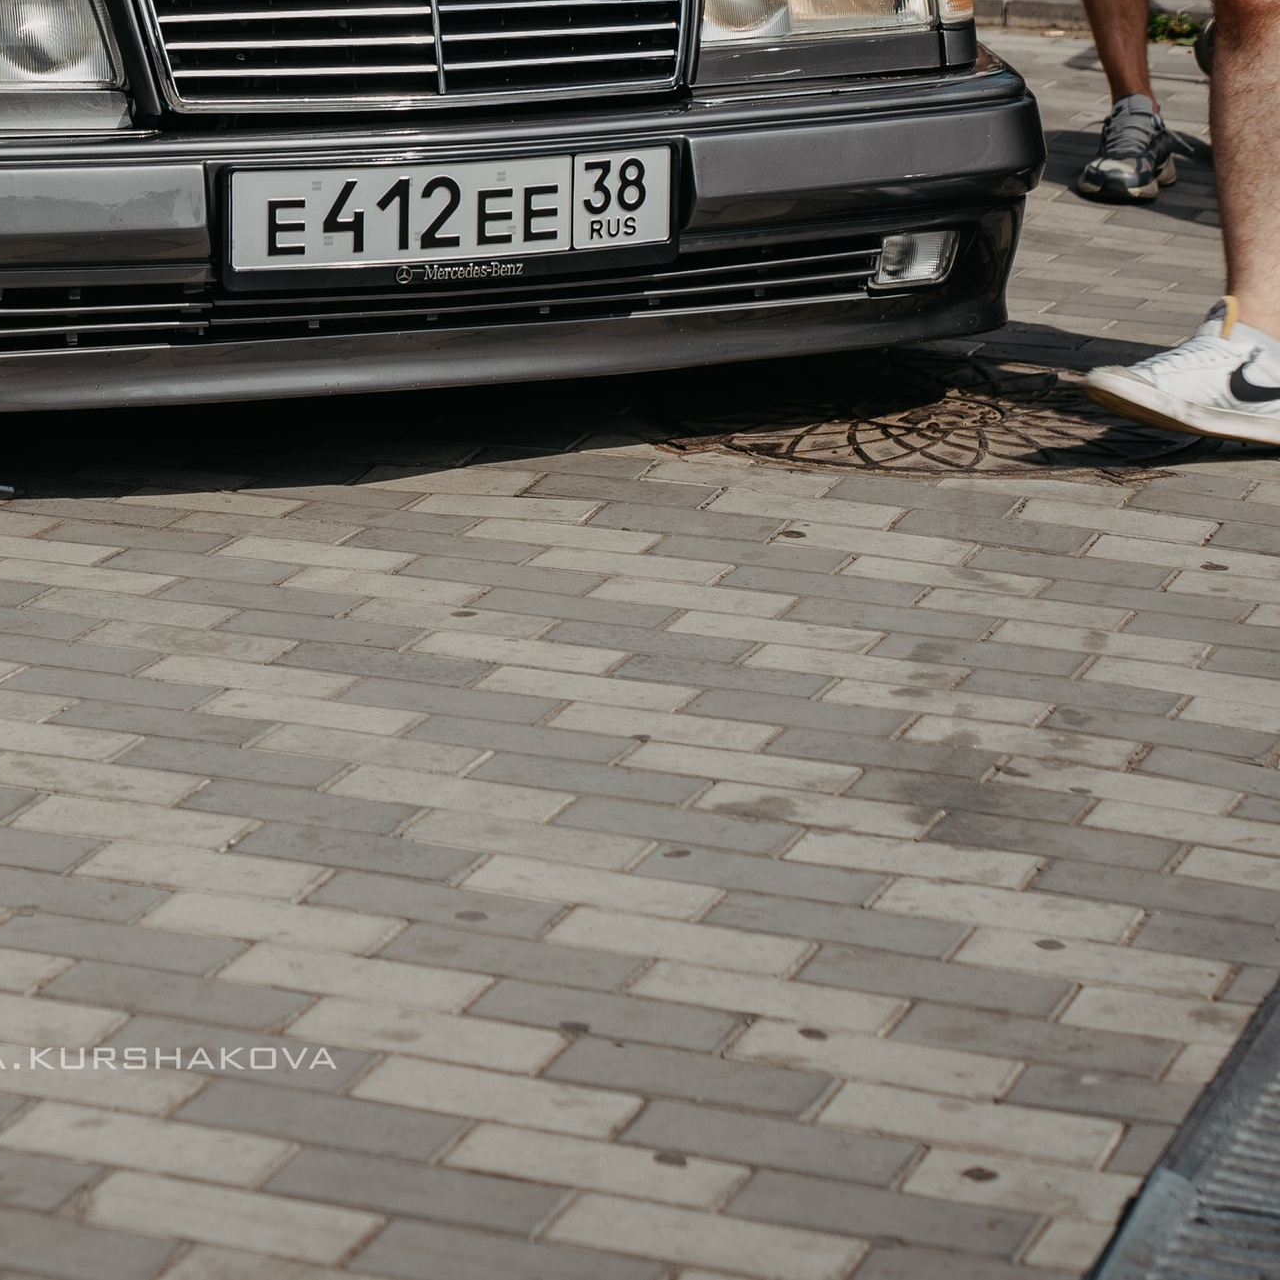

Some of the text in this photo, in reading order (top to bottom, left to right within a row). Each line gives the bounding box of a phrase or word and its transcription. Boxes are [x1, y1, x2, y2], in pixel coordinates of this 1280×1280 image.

[583, 157, 647, 215] 38
[590, 216, 637, 241] RUS
[423, 261, 524, 281] Mercedes-Benz
